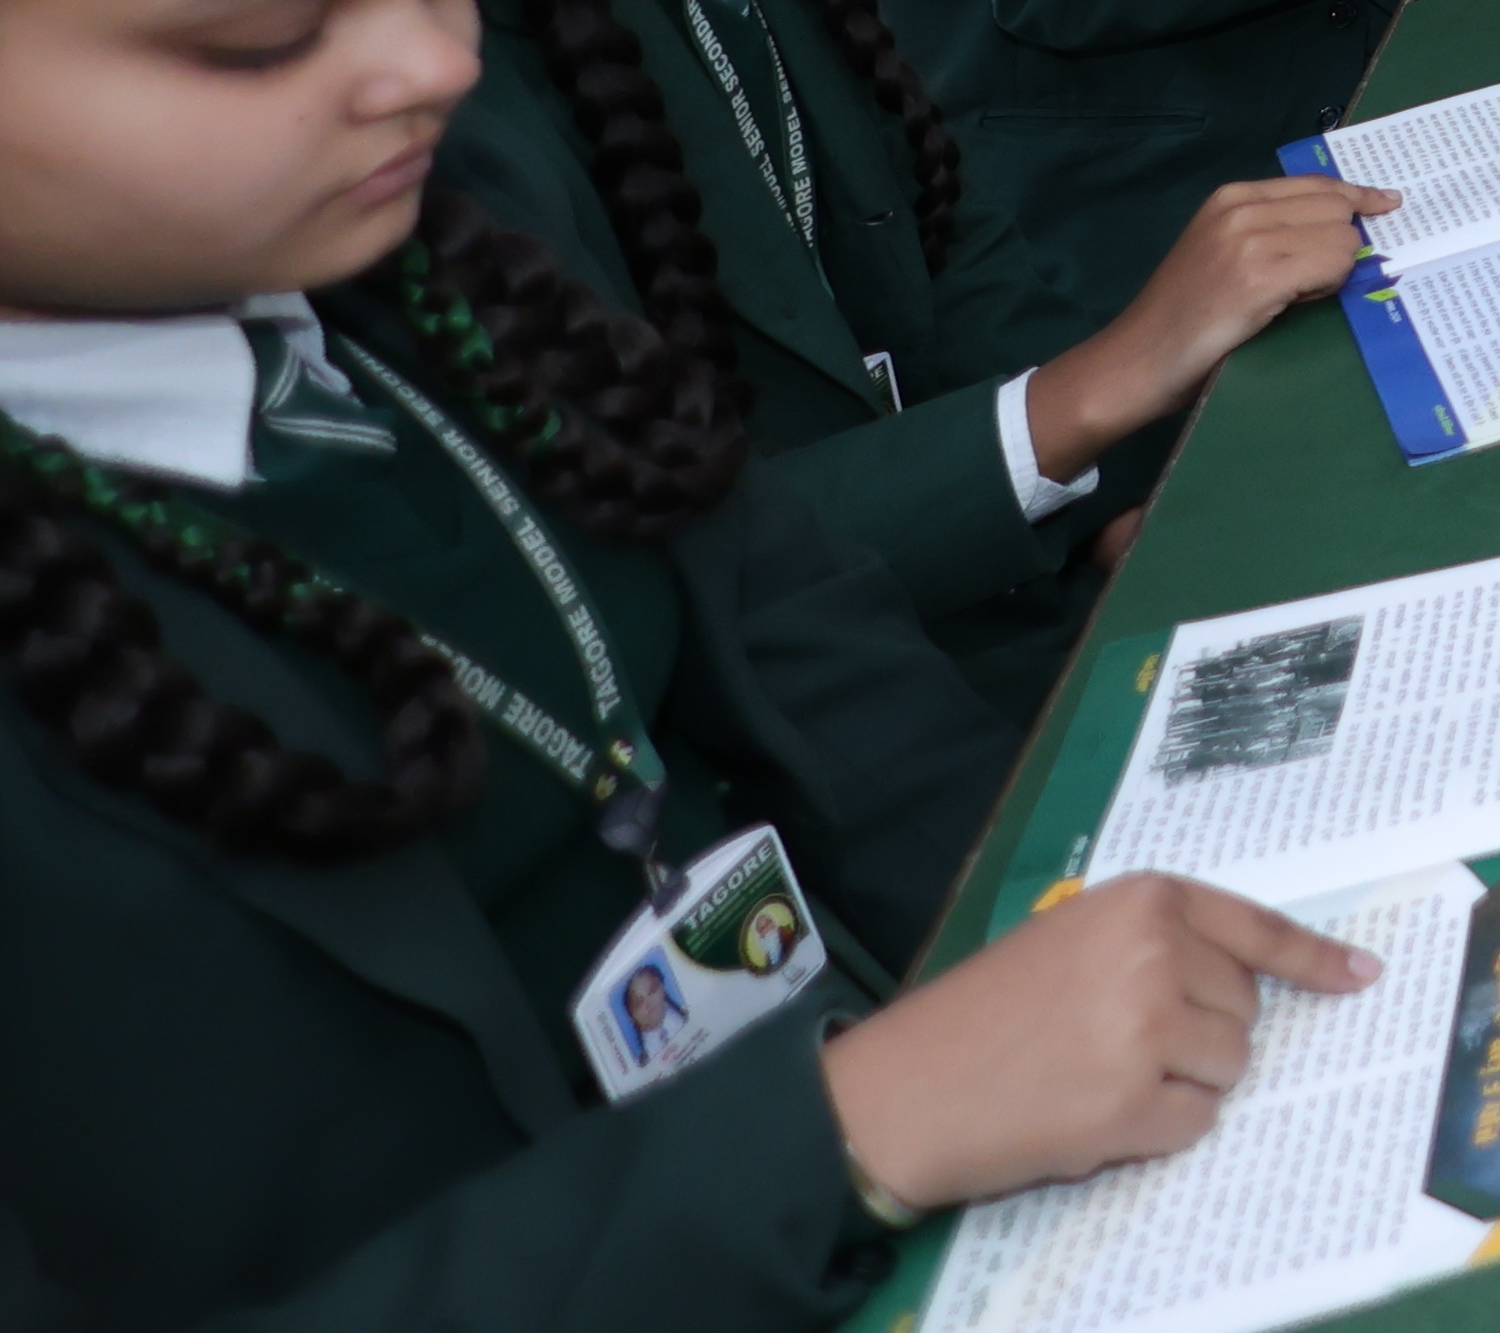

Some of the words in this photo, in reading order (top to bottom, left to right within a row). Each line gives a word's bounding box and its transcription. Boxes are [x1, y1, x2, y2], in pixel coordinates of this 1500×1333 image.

[731, 88, 765, 158] SENIOR
[787, 106, 808, 175] MODEL
[442, 429, 521, 516] SENIOR
[515, 515, 580, 606] MODEL
[568, 603, 623, 721] TAGORE
[503, 690, 595, 781] TAGORE
[682, 842, 773, 932] TAGORE
